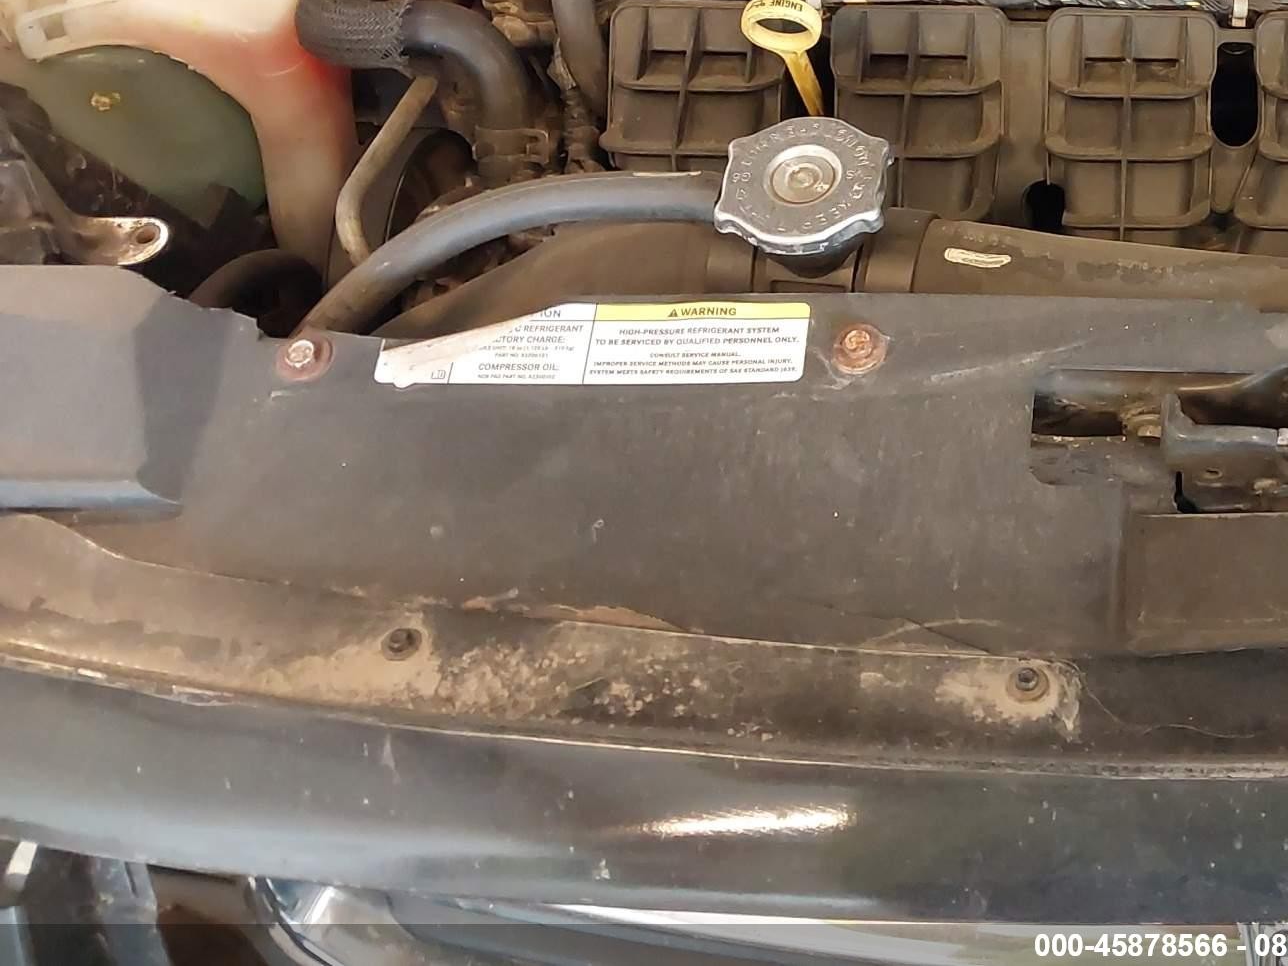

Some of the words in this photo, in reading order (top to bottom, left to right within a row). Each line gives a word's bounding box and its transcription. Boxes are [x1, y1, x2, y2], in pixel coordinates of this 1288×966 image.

[681, 307, 737, 317] WARNING
[523, 324, 584, 333] REFRIGERANT
[619, 328, 685, 336] HIGH-PRESSURE
[686, 327, 744, 335] REFRIGERANT
[596, 338, 606, 346] TO
[608, 338, 620, 346] BE
[621, 338, 662, 346] SERVICED
[676, 337, 721, 345] QUALIFIED
[723, 336, 773, 345] PERSONNEL
[478, 363, 541, 372] COMPRESSOR
